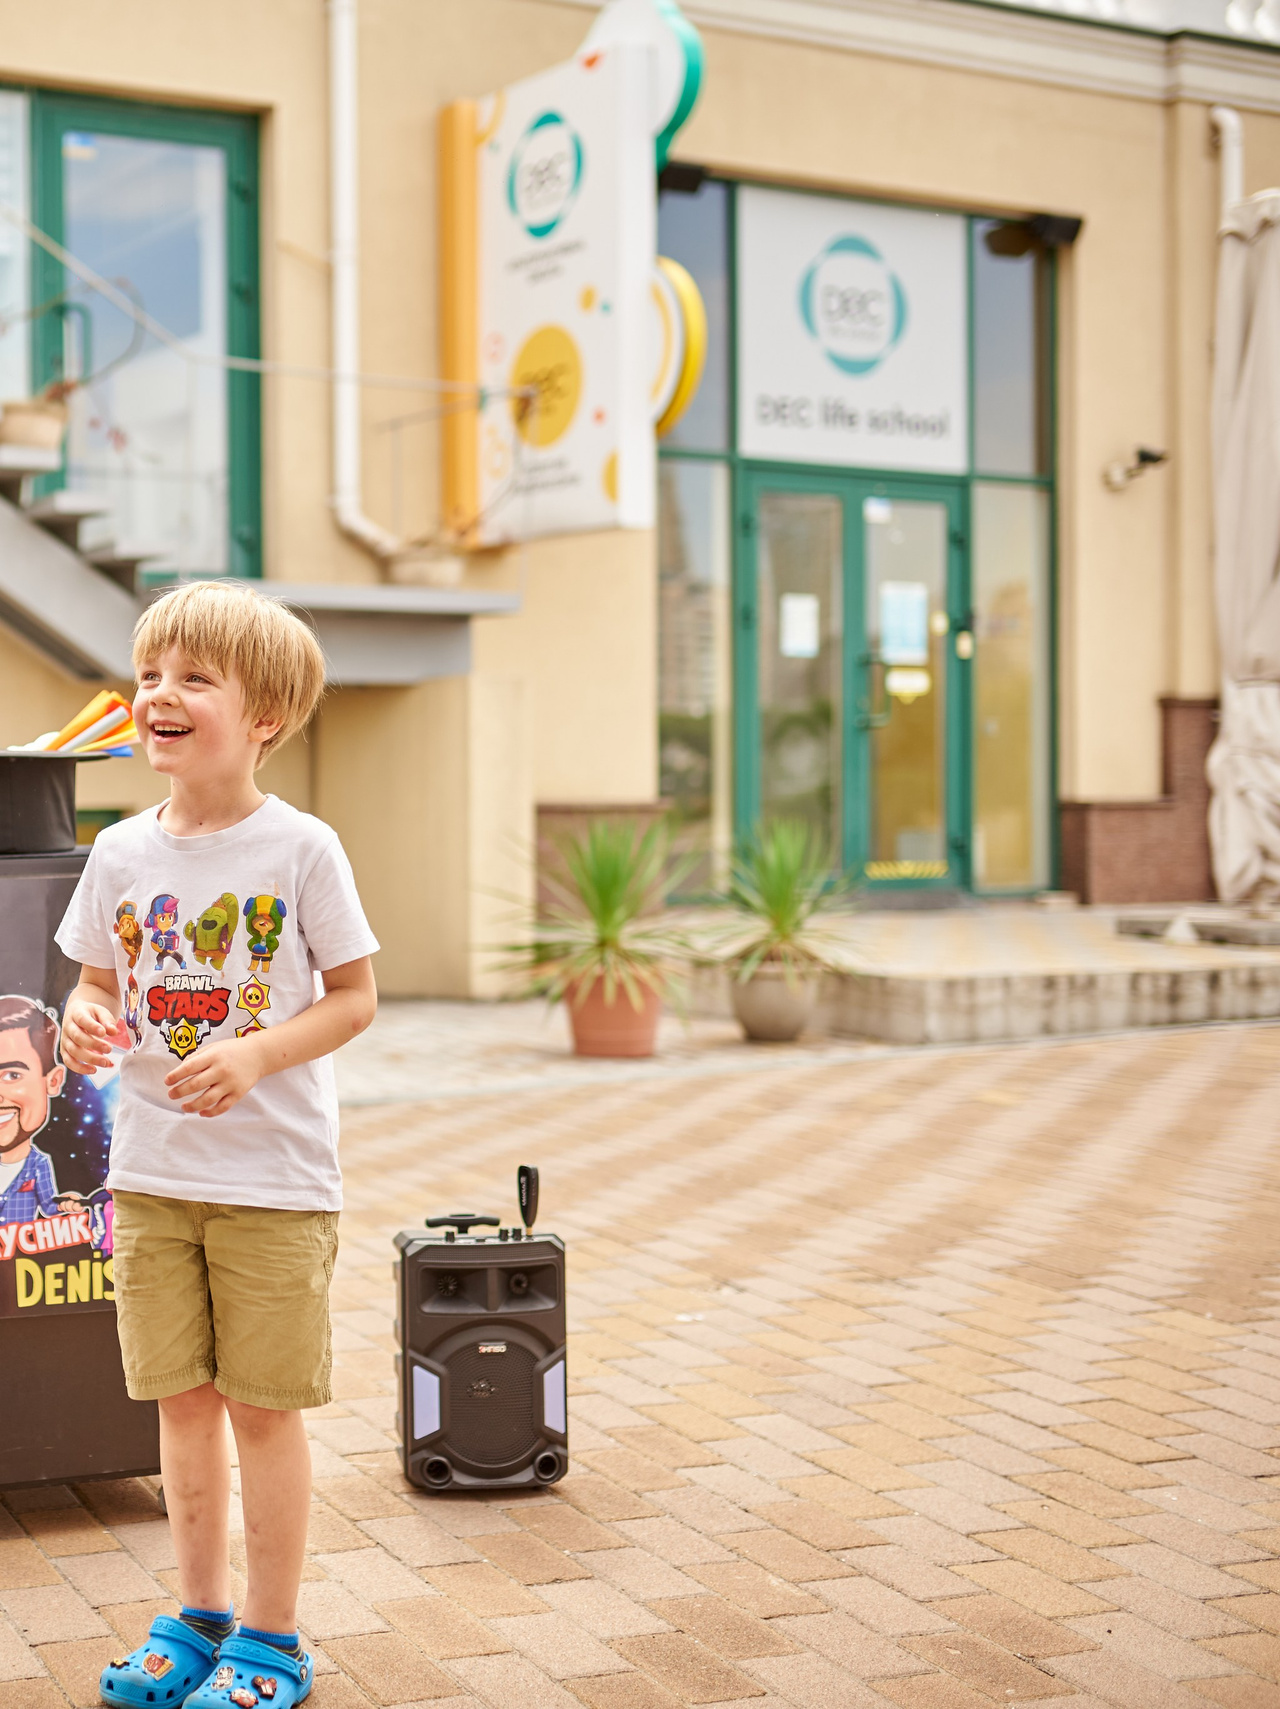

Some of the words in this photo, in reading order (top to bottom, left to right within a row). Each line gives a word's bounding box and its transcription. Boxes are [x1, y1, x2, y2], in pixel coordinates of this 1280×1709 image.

[756, 394, 813, 428] DEC
[821, 397, 859, 431] life
[867, 404, 950, 438] school
[164, 975, 214, 991] BRAWL
[147, 985, 231, 1022] STARS
